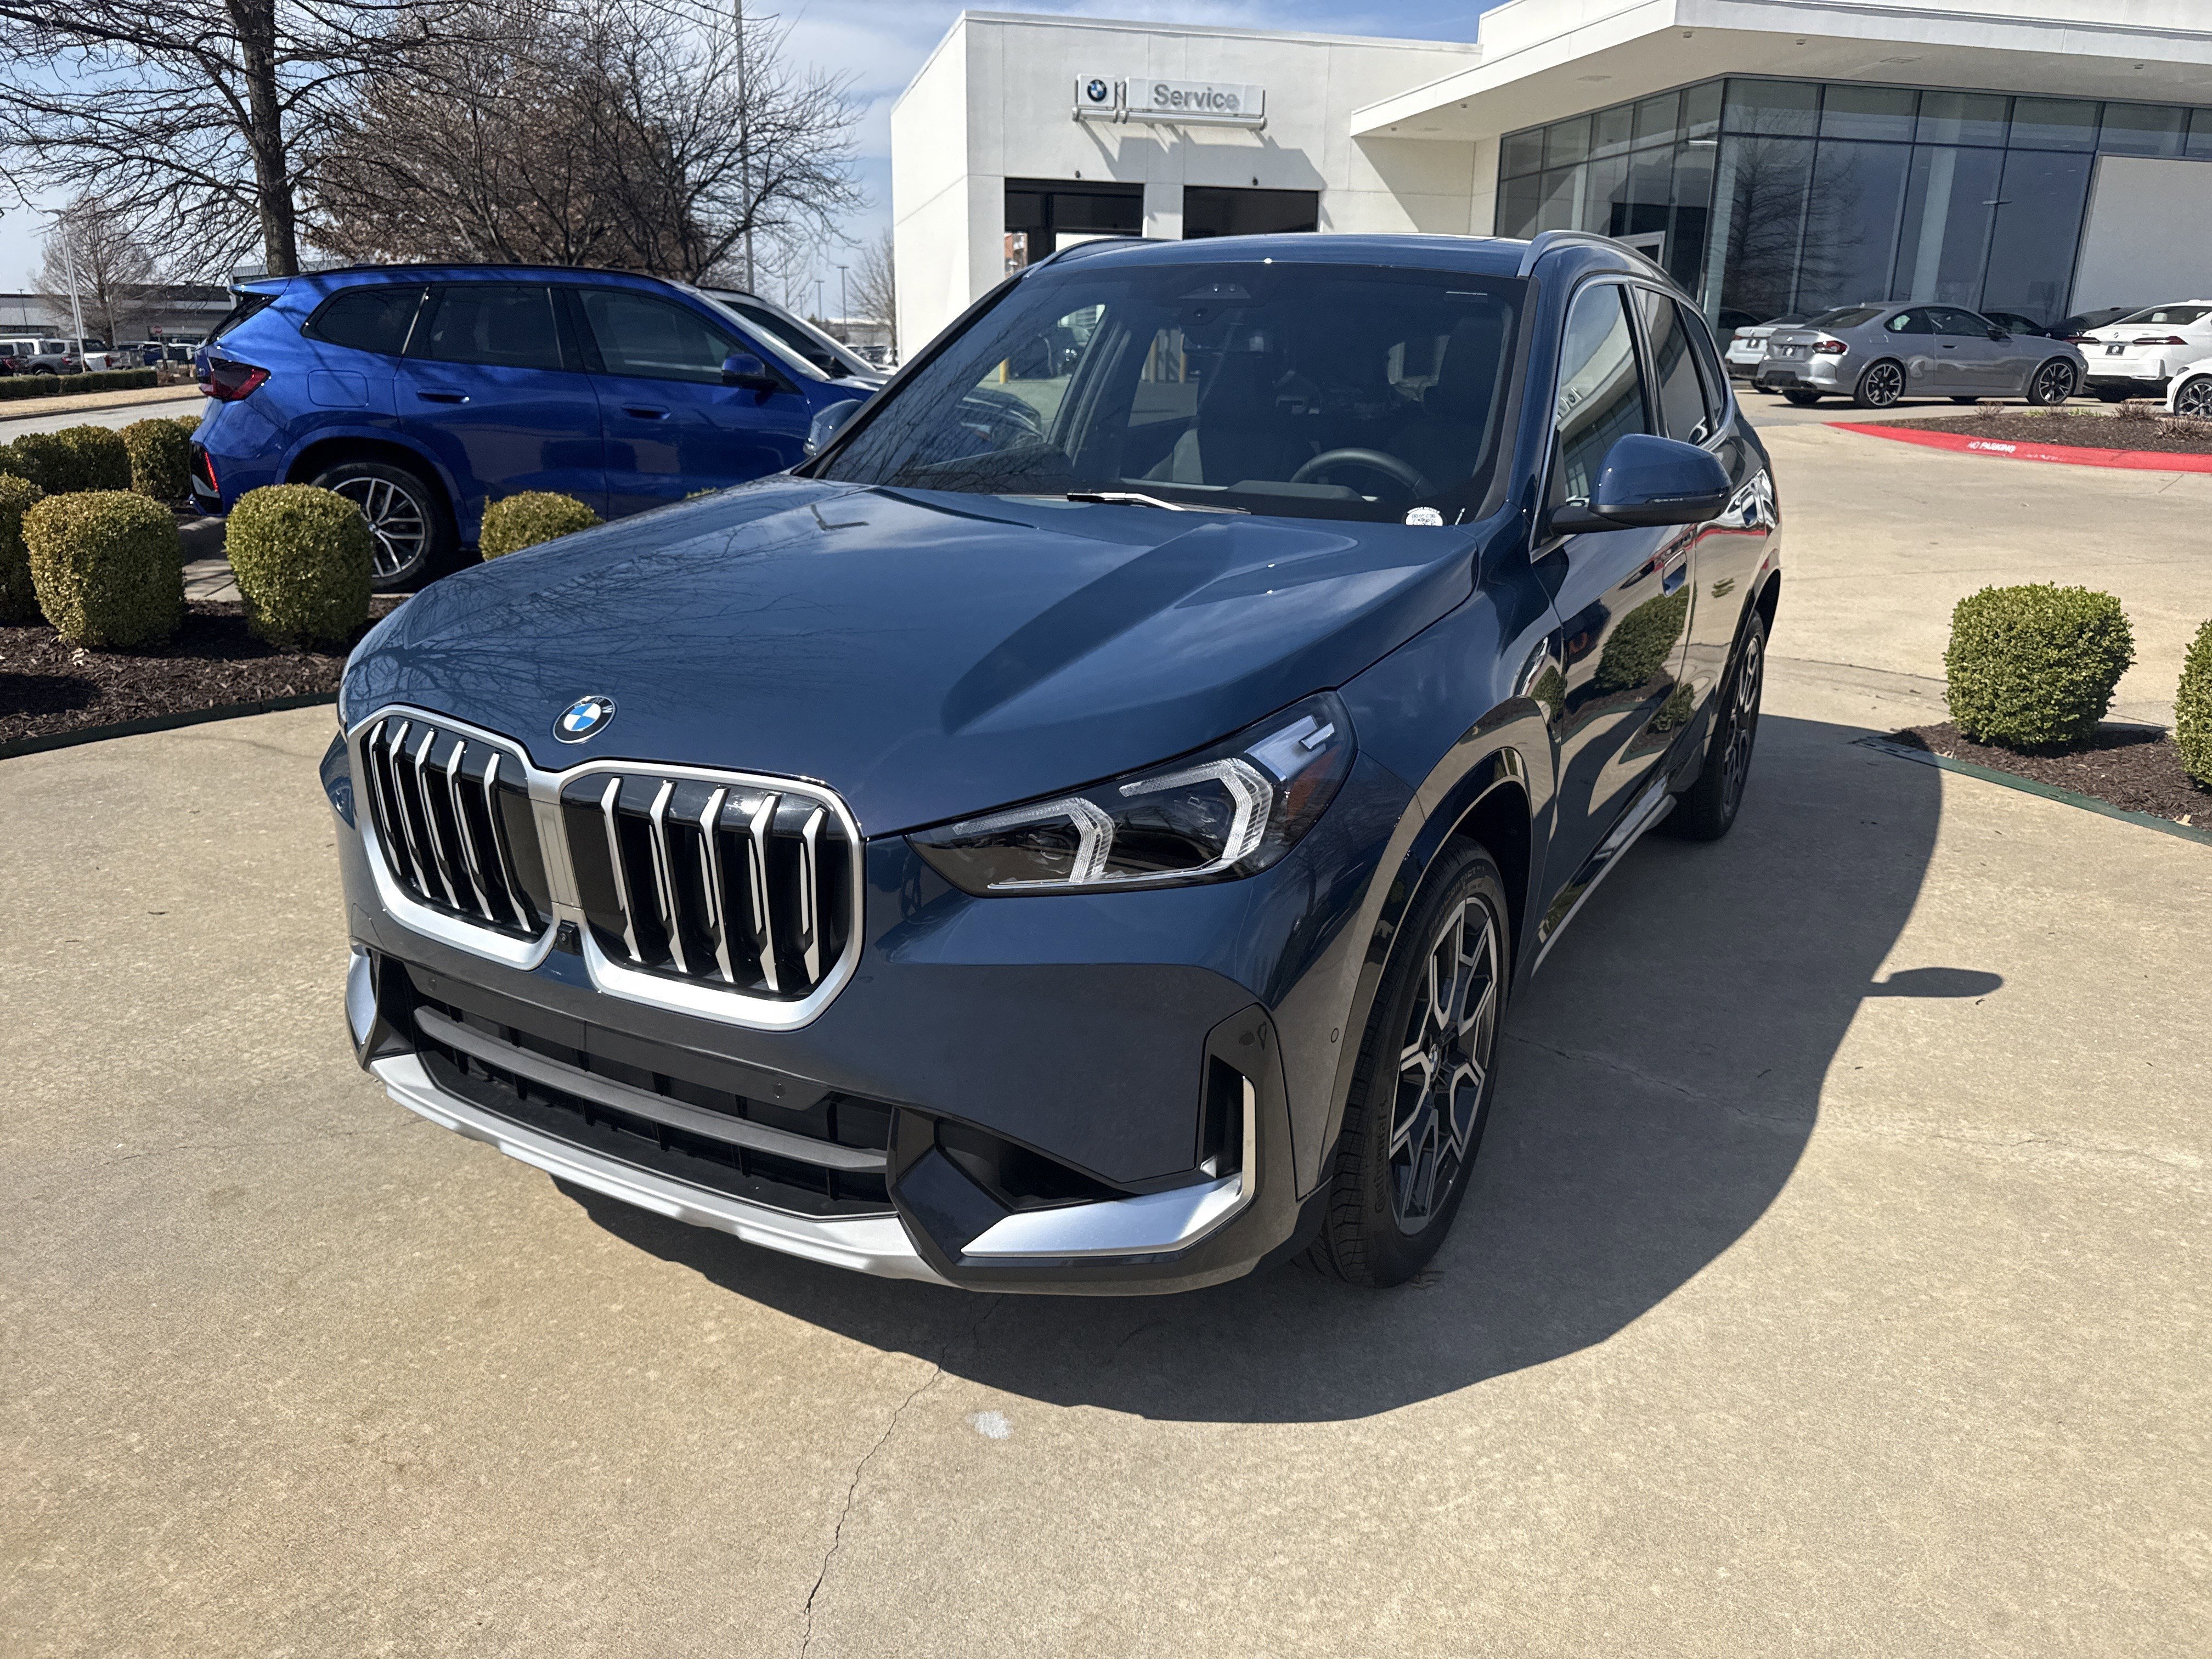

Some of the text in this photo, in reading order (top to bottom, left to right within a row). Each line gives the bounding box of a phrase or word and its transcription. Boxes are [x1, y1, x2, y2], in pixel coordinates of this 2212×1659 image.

[1153, 83, 1239, 109] Service
[1967, 441, 2016, 453] NO PARKING
